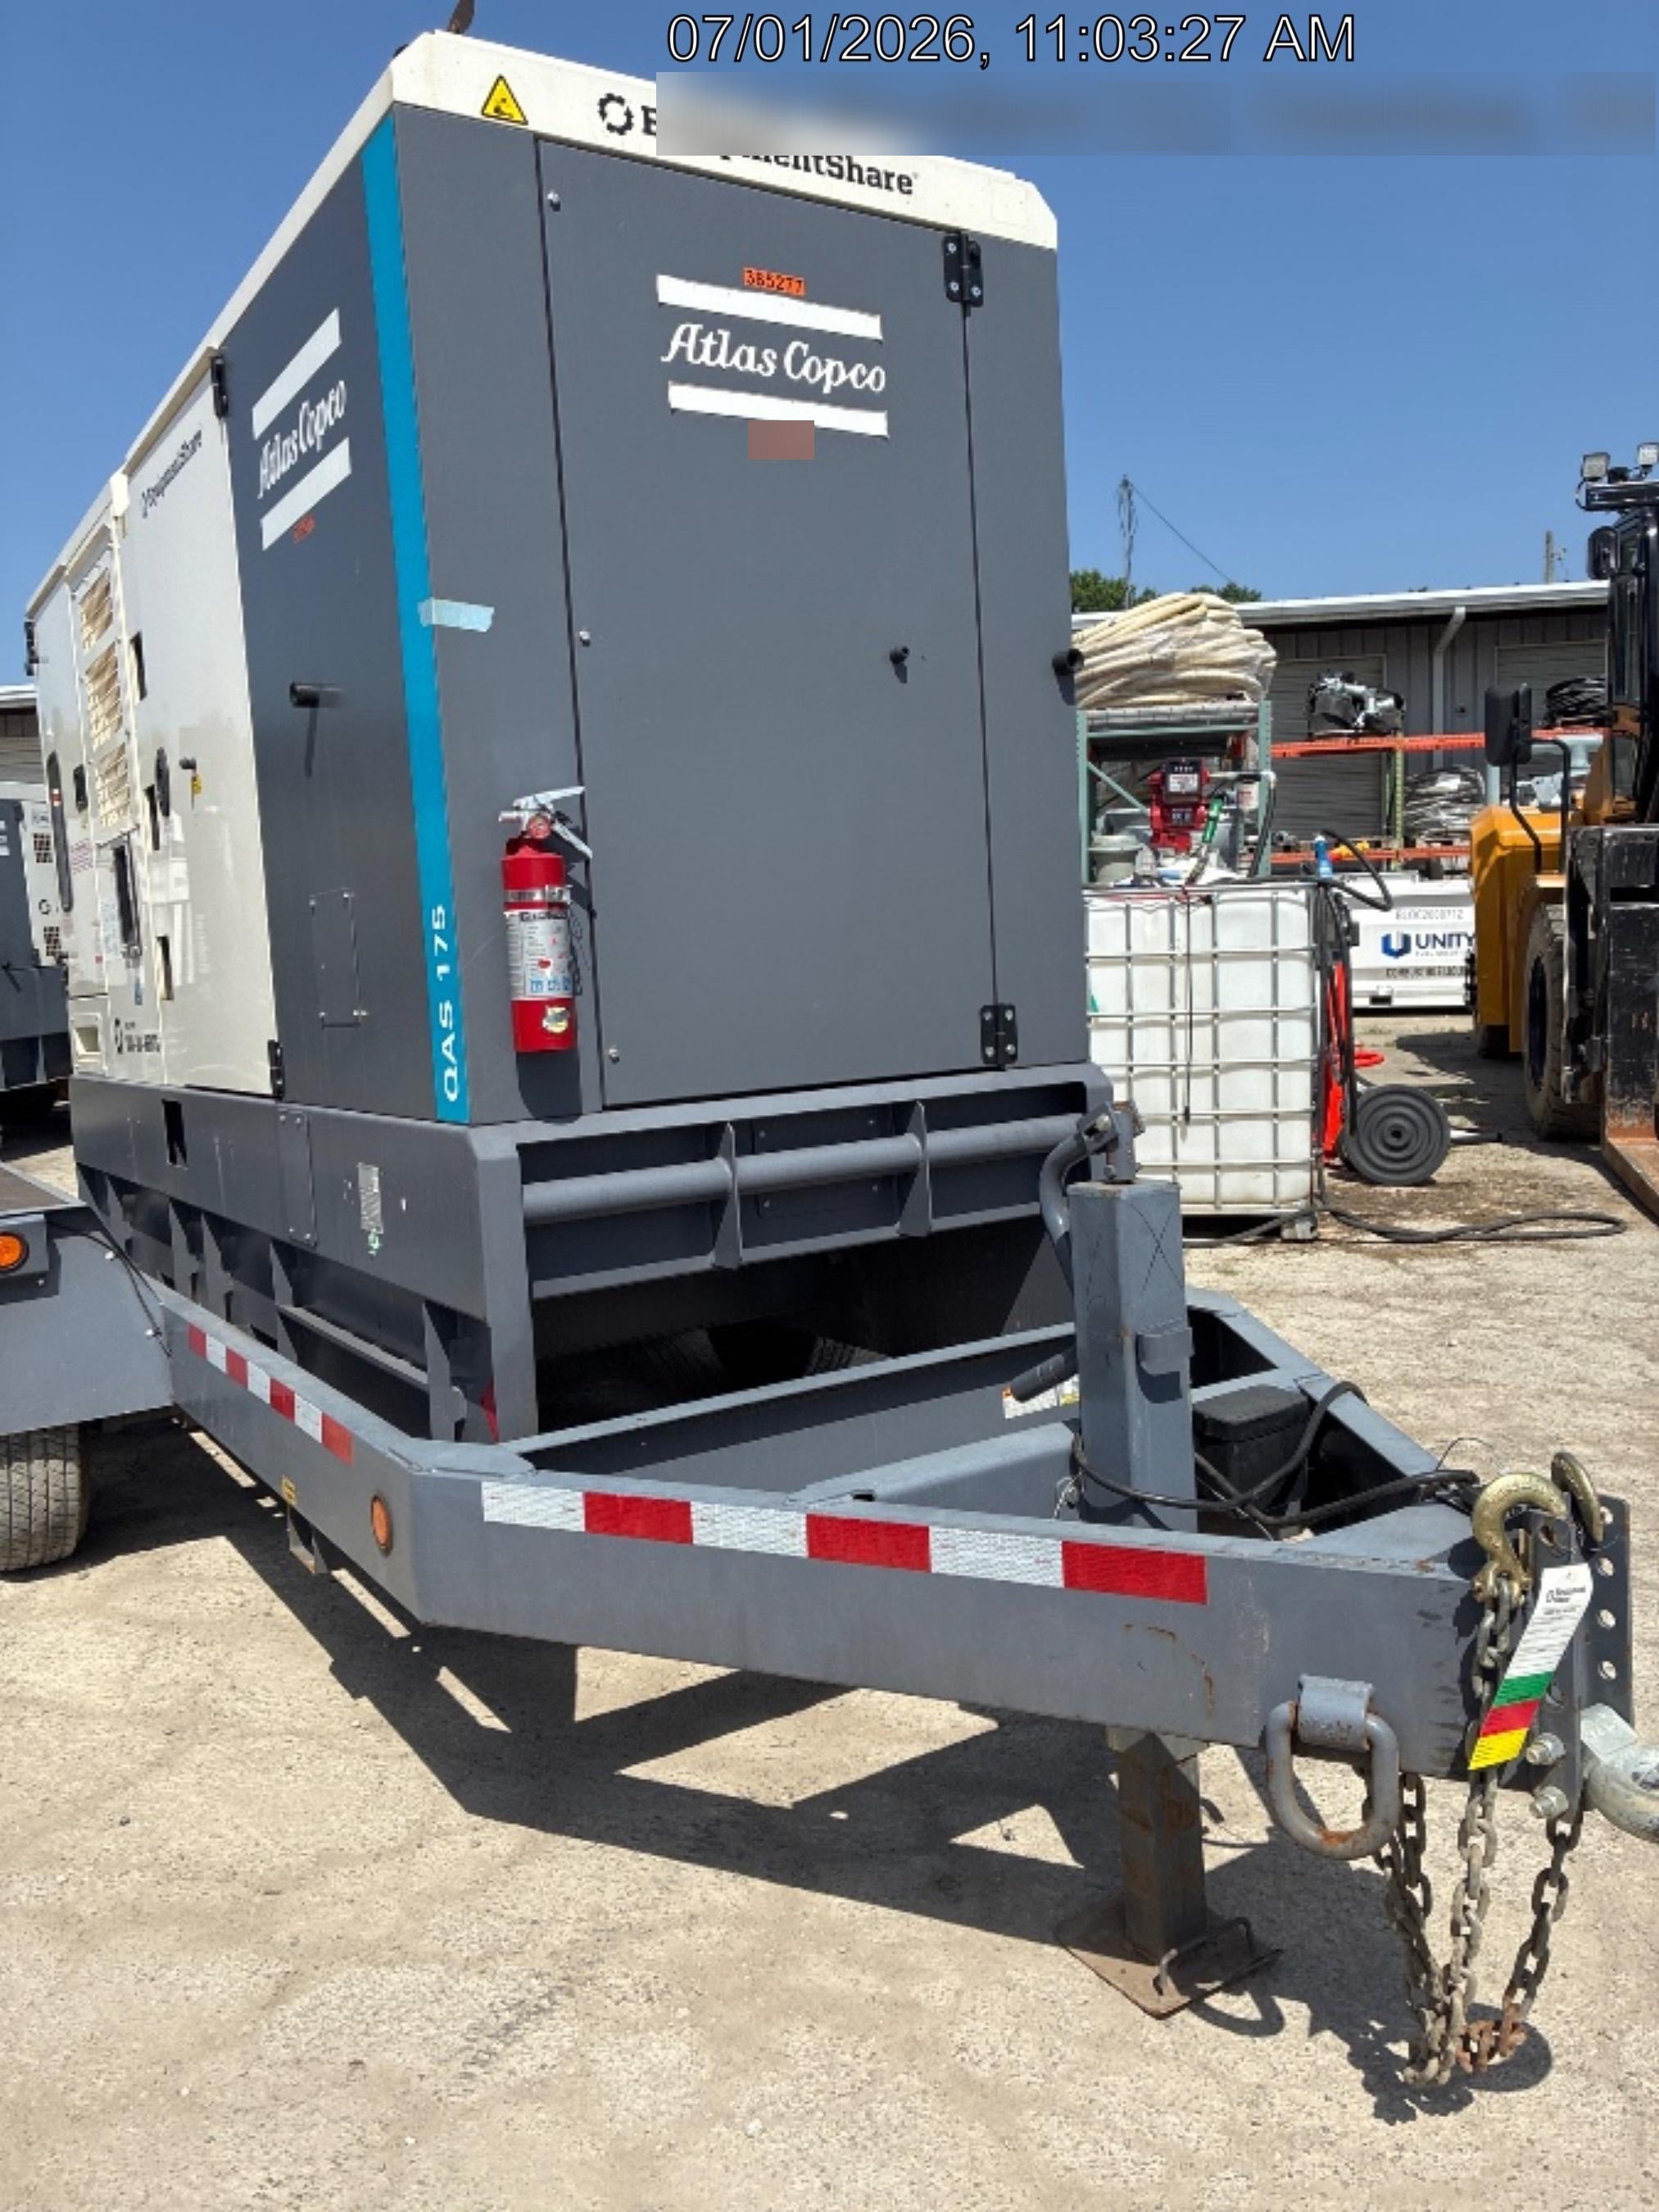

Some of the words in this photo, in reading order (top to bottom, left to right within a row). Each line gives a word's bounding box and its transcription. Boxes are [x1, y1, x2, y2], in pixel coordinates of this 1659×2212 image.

[660, 322, 777, 378] Atlas
[784, 340, 886, 394] Copco
[257, 430, 298, 500] Atlas
[299, 379, 347, 452] Copco
[432, 904, 451, 981] 175
[1415, 932, 1475, 950] UNITY
[439, 999, 460, 1102] QAS
